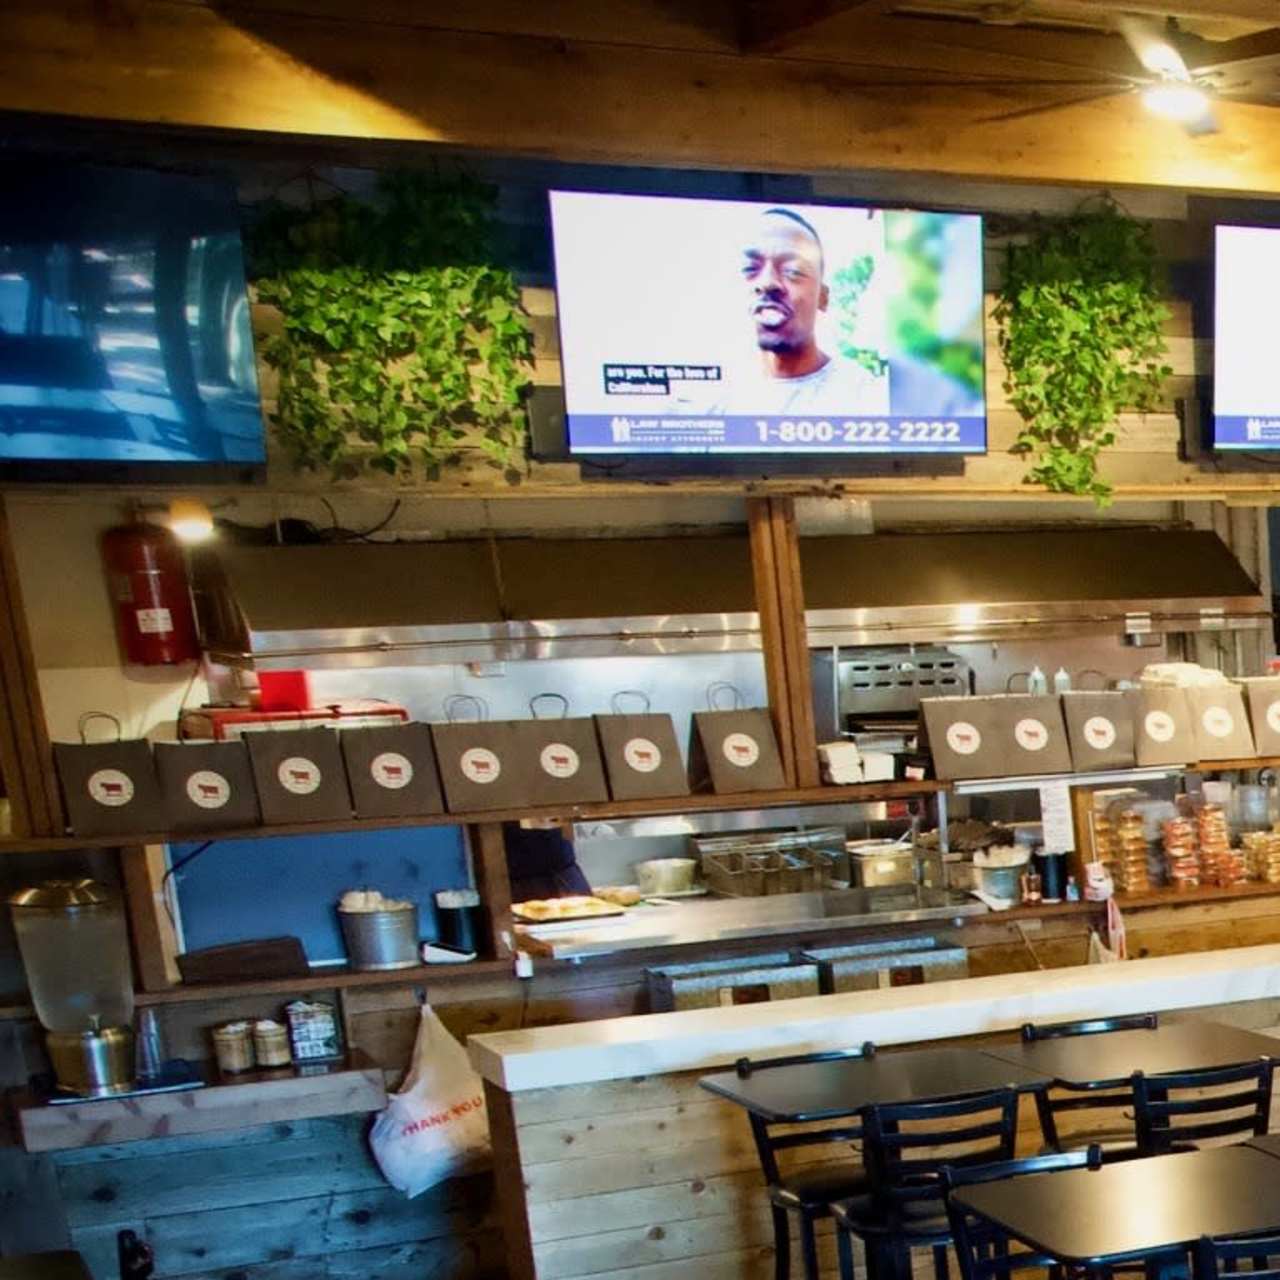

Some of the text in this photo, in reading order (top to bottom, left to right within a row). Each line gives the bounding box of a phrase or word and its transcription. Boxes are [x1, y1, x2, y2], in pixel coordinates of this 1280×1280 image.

[756, 420, 961, 442] 1-800-222-2222
[402, 1096, 482, 1137] THANK YOU
